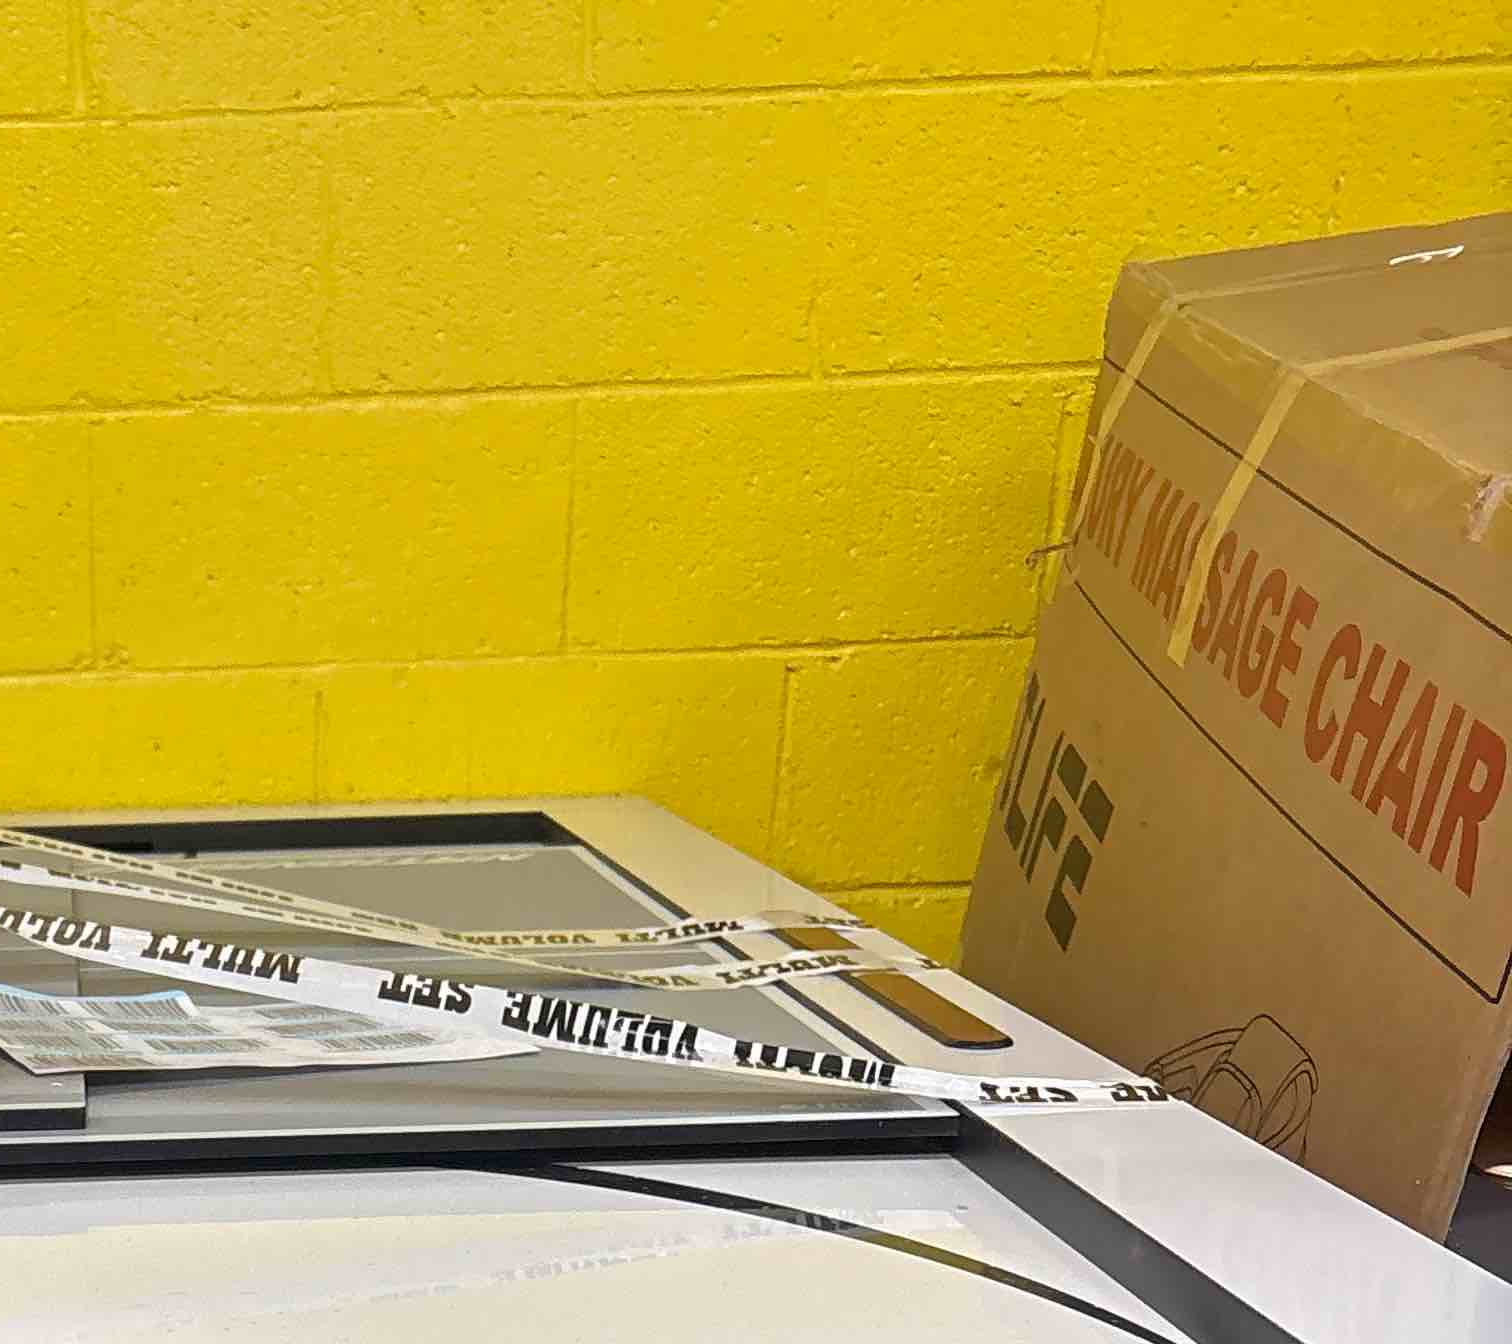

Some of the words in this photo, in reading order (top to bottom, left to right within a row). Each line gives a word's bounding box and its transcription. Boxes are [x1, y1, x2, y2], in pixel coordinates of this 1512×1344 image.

[1303, 623, 1507, 899] CHAIR
[140, 931, 304, 984] MULTI
[377, 971, 476, 1015] SET
[500, 993, 703, 1063] VOLUME
